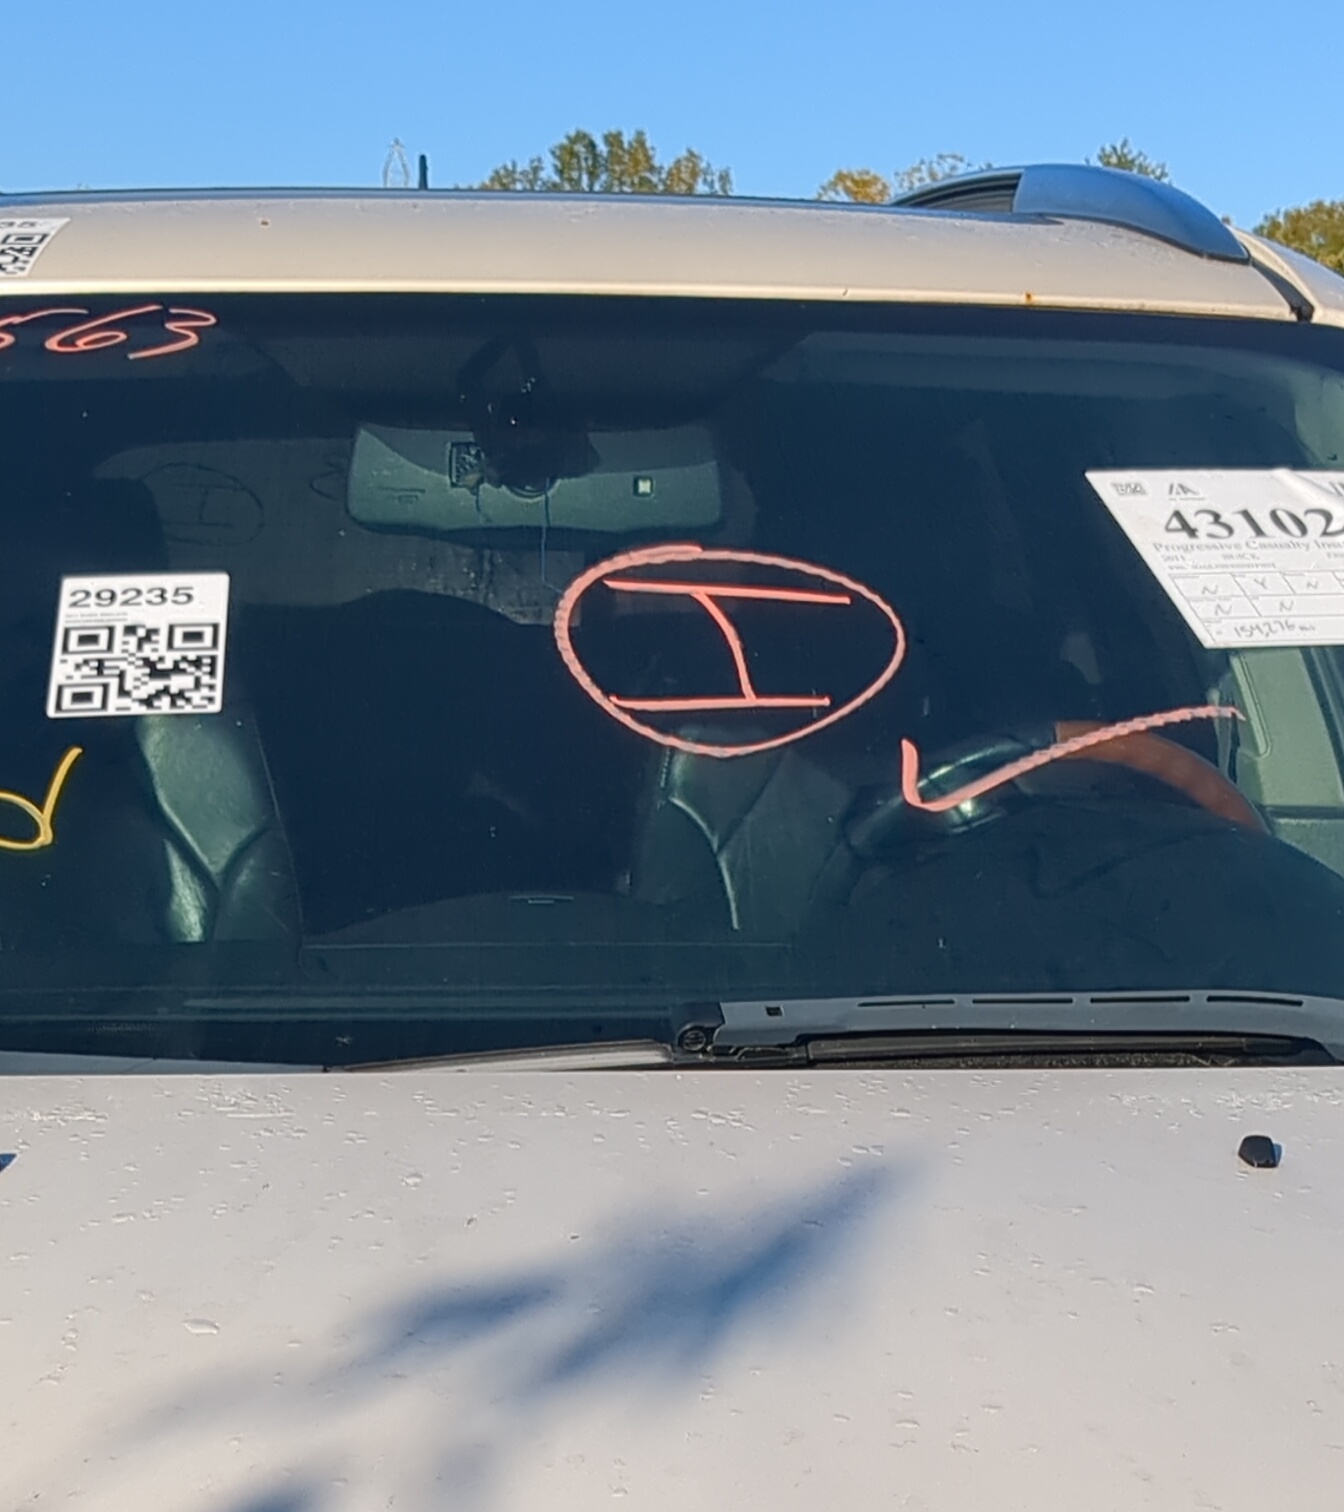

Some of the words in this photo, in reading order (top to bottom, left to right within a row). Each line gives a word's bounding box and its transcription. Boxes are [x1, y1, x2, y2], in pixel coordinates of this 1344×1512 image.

[1154, 542, 1243, 554] Progressive
[1245, 539, 1311, 552] Casualty
[68, 586, 195, 608] 29235
